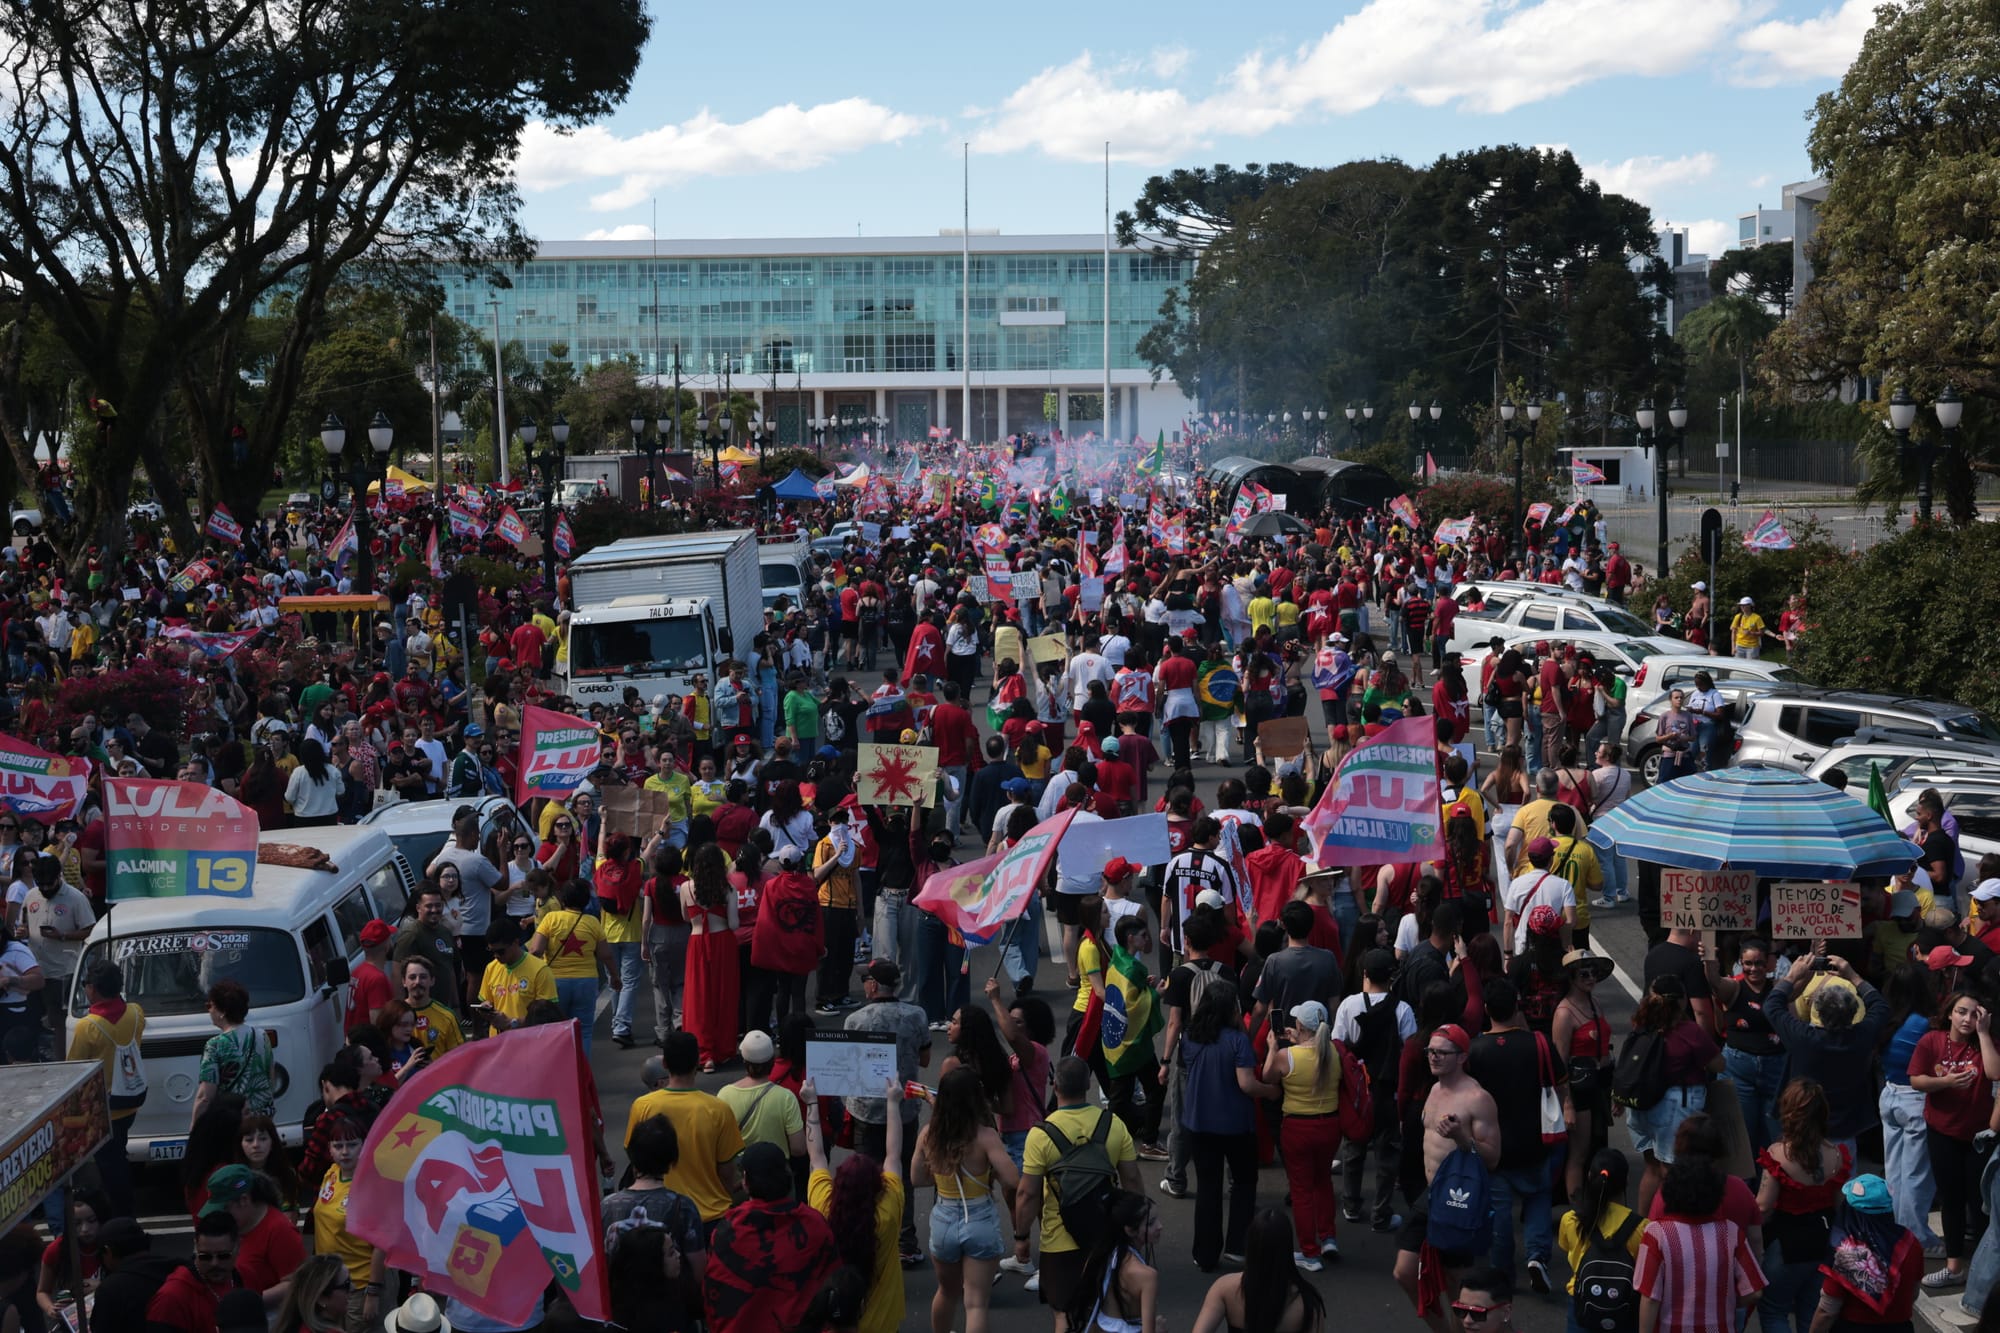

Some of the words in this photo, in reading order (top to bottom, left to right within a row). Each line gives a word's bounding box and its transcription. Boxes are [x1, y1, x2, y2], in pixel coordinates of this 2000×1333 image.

[210, 516, 243, 536] LULA
[650, 608, 661, 617] TAL
[664, 606, 673, 616] DO
[578, 685, 614, 694] CARGO
[1125, 676, 1146, 691] PT
[105, 782, 242, 818] LULA
[196, 857, 248, 892] 13
[1664, 874, 1750, 896] TESOURAÇO
[1684, 893, 1691, 911] É
[1697, 893, 1720, 911] SÓ
[1776, 888, 1826, 901] TEMOS
[1831, 888, 1839, 900] O
[1778, 902, 1825, 915] DIREITO
[1832, 904, 1844, 914] DE
[1664, 911, 1672, 921] 13
[1676, 912, 1696, 927] NA
[1702, 914, 1738, 928] CAMA
[1802, 913, 1844, 926] VOLTAR
[1787, 925, 1807, 936] PRA
[1815, 926, 1840, 936] CASA
[221, 934, 249, 943] 2026
[0, 1120, 54, 1190] REVERO
[1, 1180, 26, 1219] HOT
[27, 1155, 52, 1191] DOG
[1446, 1200, 1468, 1209] adidas
